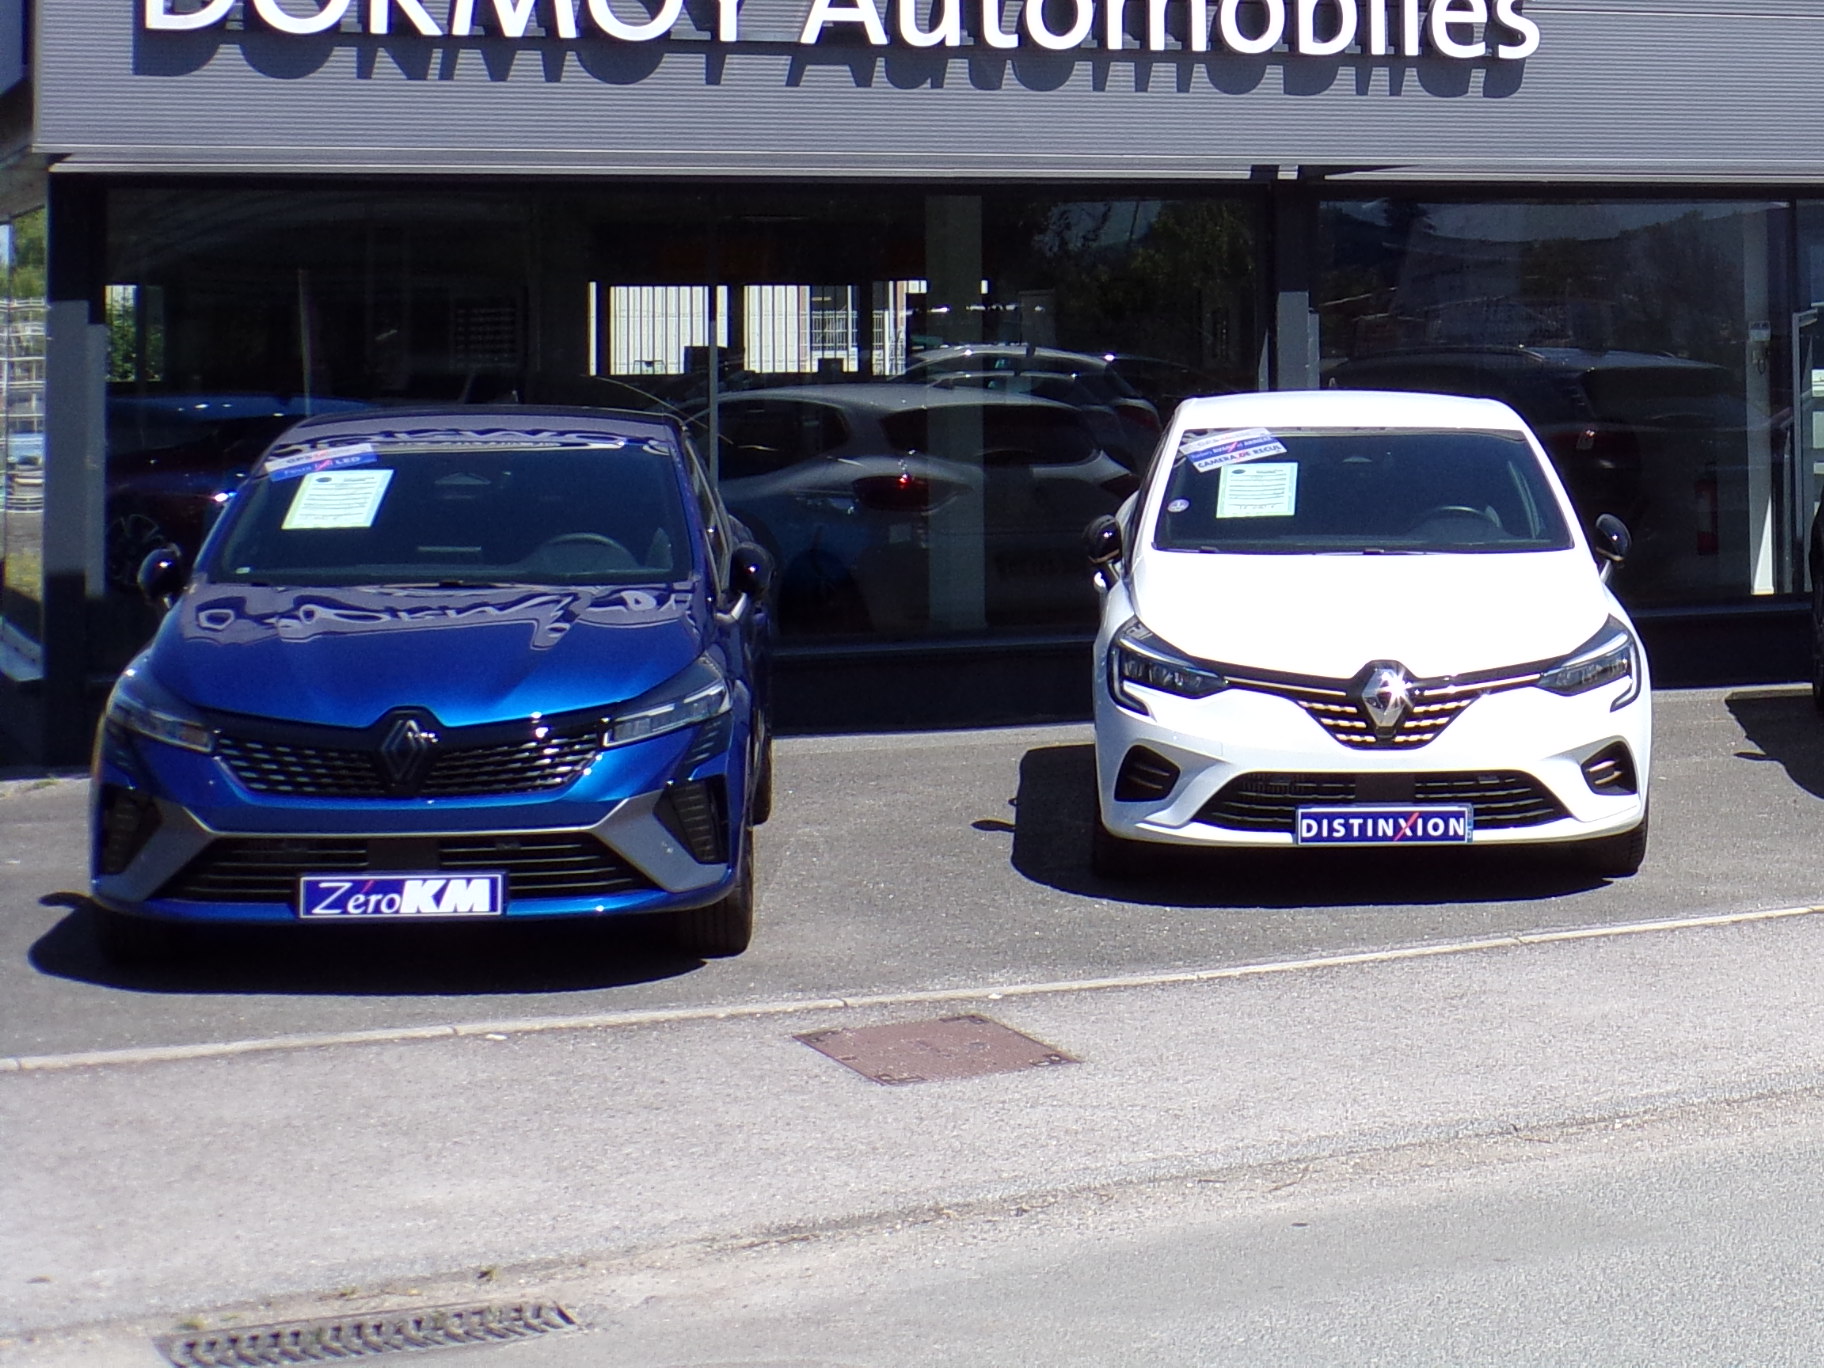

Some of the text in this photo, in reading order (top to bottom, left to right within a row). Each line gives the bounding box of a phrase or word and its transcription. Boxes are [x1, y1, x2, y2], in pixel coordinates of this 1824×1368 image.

[335, 456, 361, 465] LED
[1197, 454, 1236, 468] CAMERA
[1253, 444, 1282, 455] RECUL
[1301, 811, 1465, 842] DISTINXION
